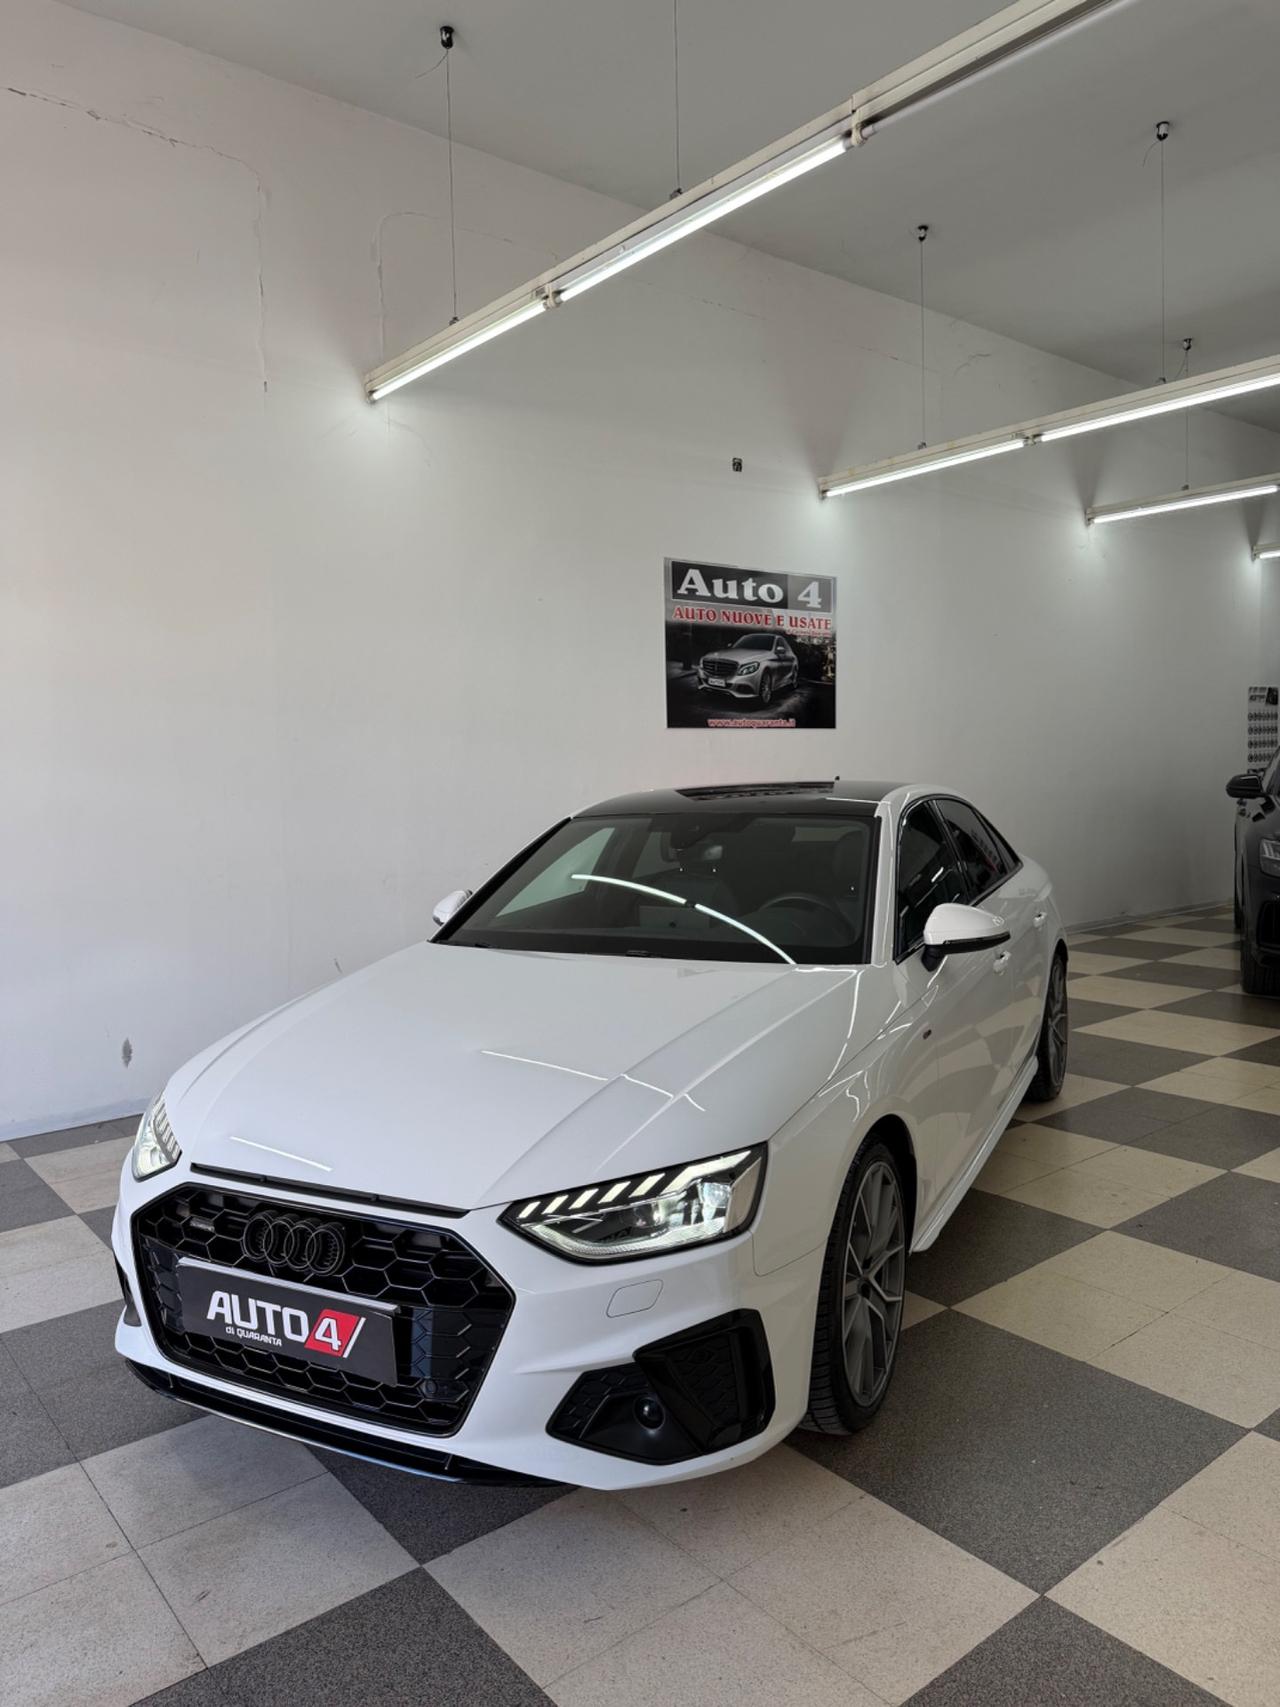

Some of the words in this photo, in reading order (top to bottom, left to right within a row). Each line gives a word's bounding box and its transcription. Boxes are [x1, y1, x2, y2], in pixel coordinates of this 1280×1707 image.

[677, 568, 784, 604] Auto
[797, 581, 822, 608] 4
[673, 607, 717, 622] AUTO
[720, 610, 772, 627] NUOVE
[776, 614, 785, 627] E
[788, 615, 832, 630] USATE
[236, 1328, 283, 1347] QUARANTA
